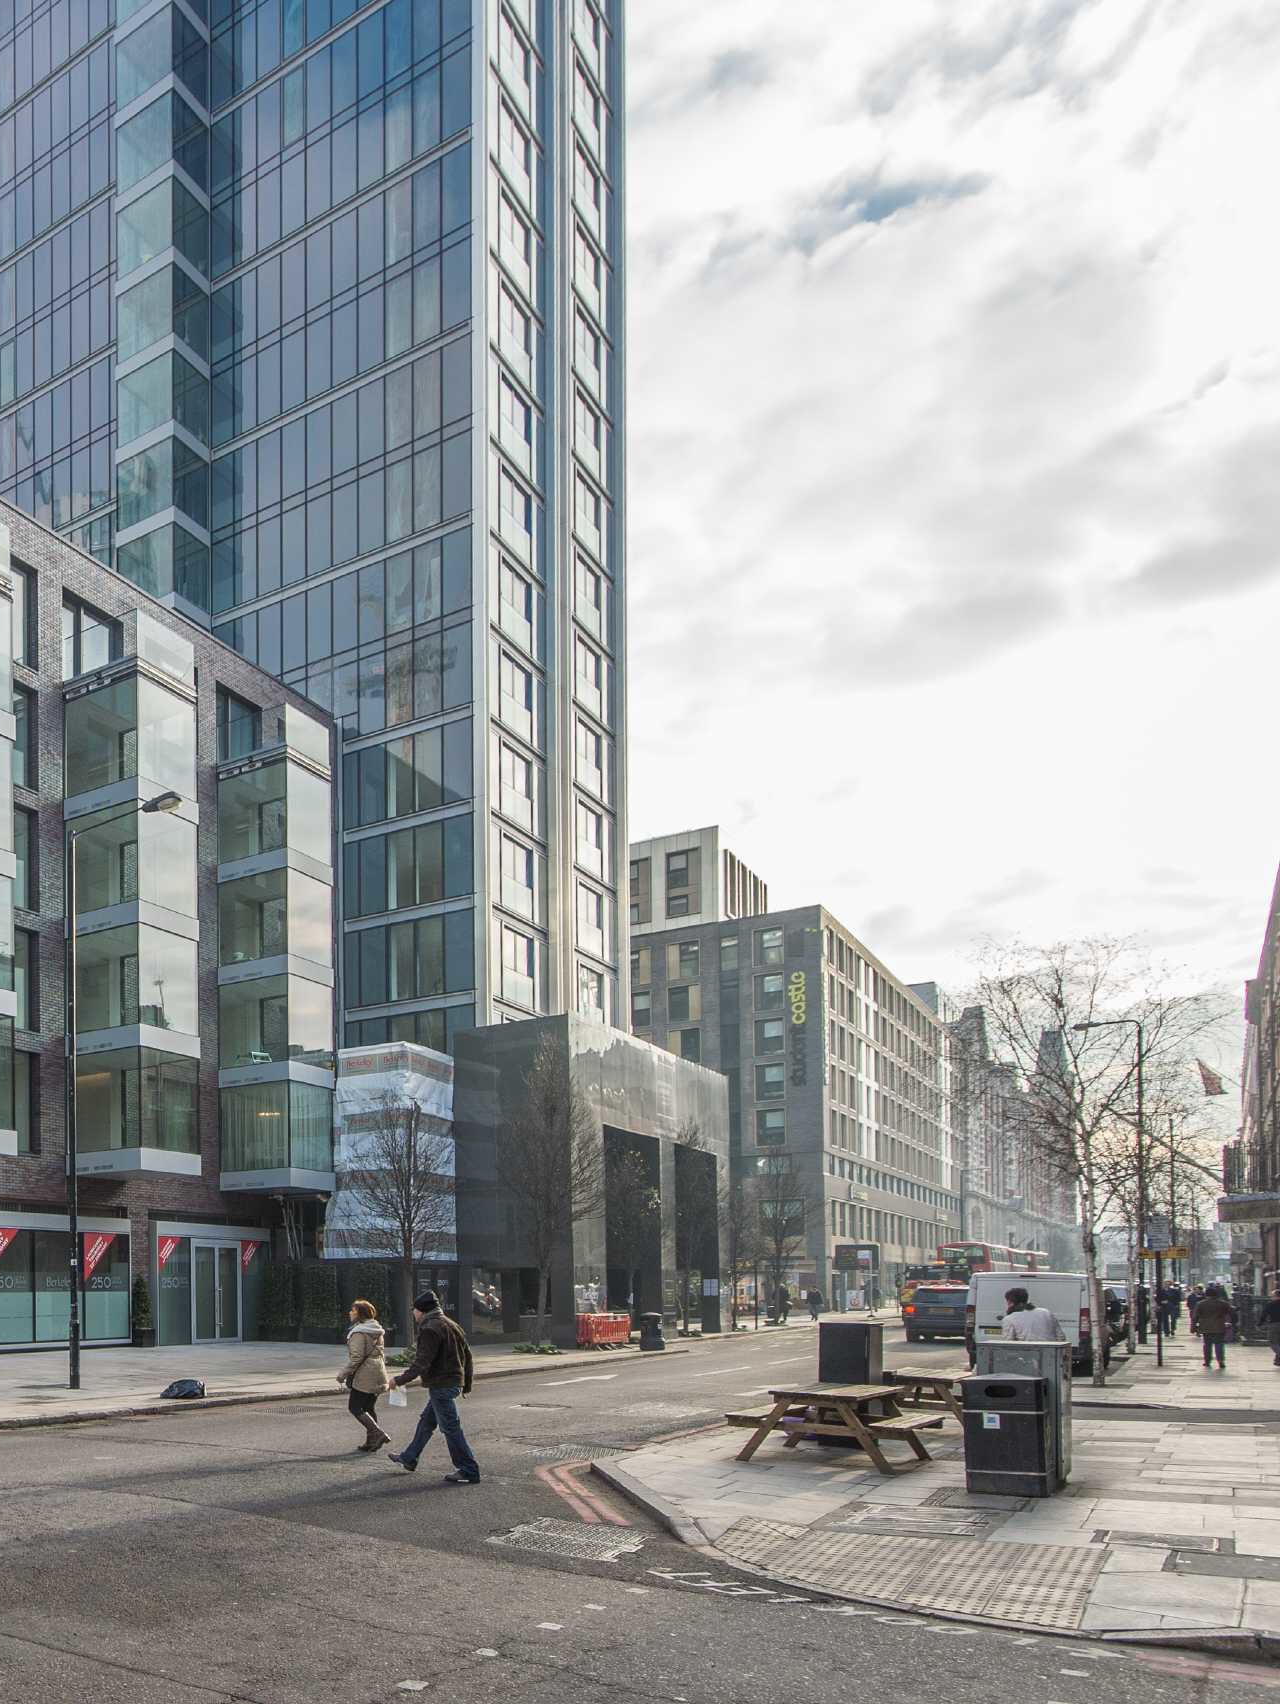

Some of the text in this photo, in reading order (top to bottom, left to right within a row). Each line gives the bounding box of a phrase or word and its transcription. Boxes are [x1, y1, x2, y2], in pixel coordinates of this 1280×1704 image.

[788, 970, 806, 1025] castle
[91, 1276, 112, 1289] 250
[646, 1570, 812, 1602] LEFT
